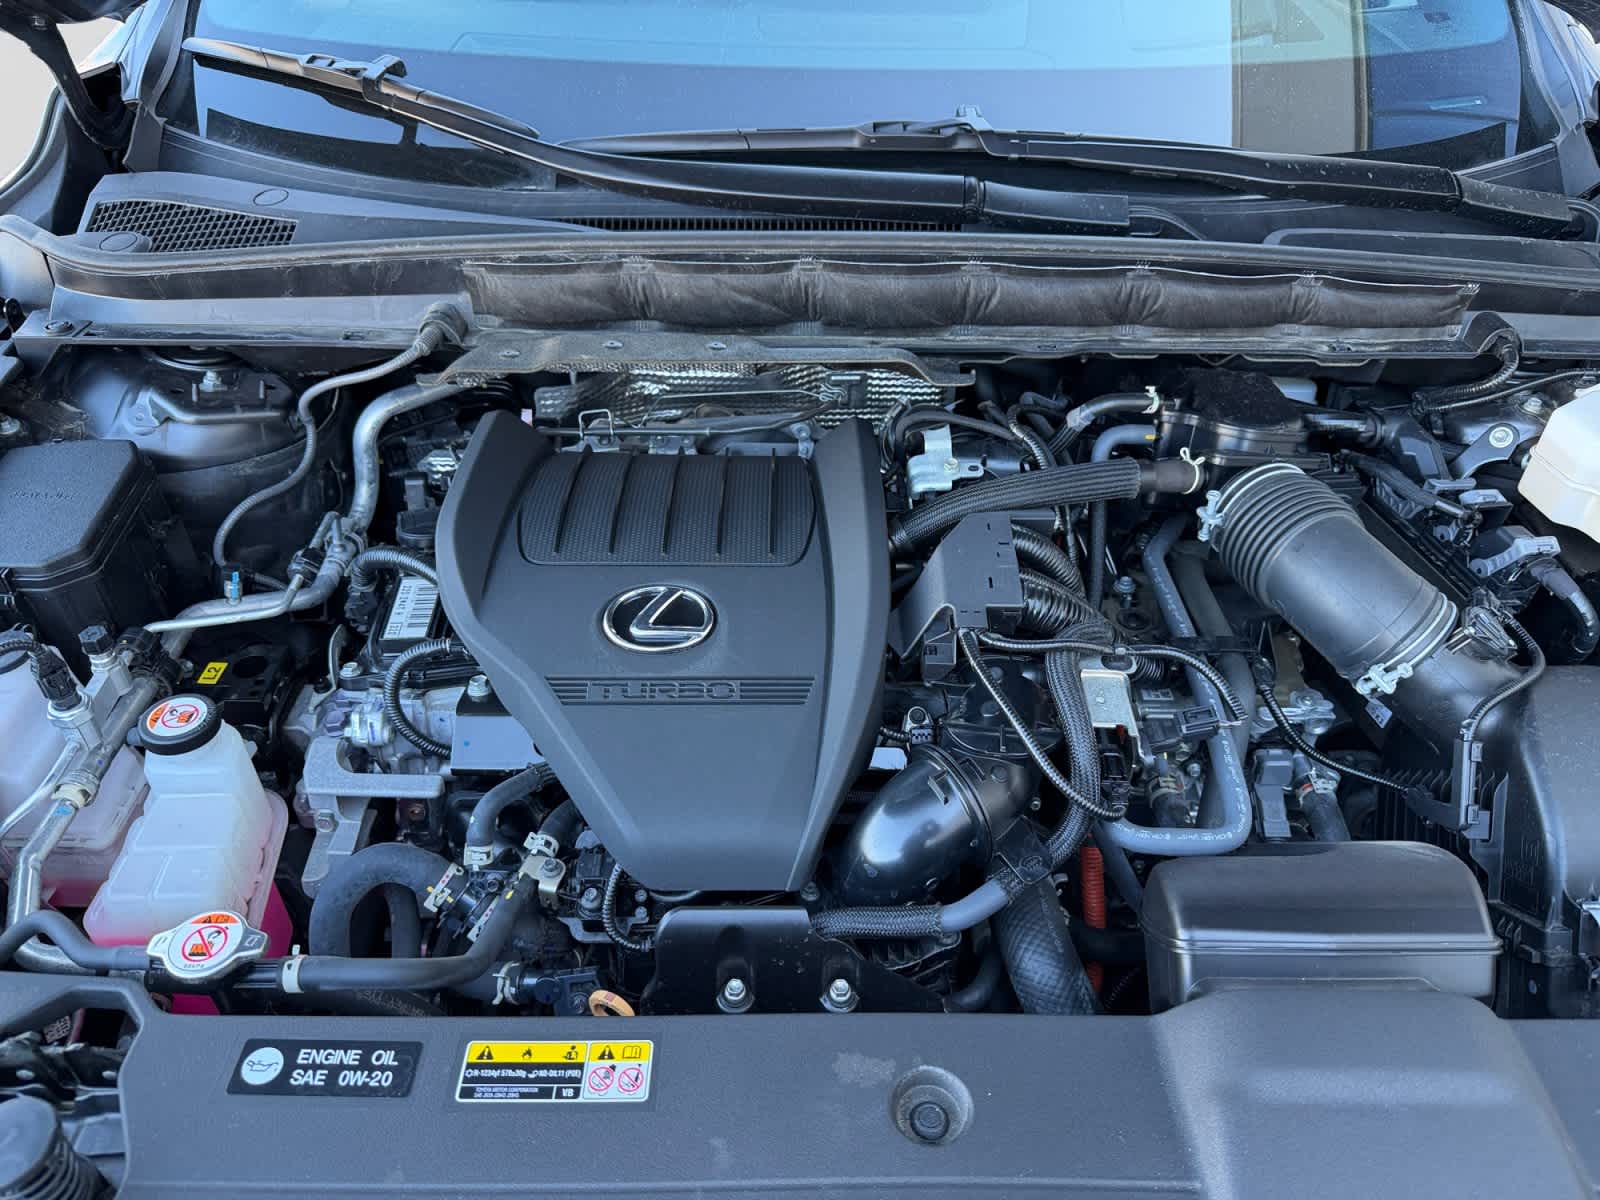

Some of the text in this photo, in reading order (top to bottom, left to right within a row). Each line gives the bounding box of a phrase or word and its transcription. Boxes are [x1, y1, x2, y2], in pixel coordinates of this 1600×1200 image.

[590, 680, 738, 700] TURBO
[296, 1048, 399, 1067] ENGINE OIL
[289, 1069, 393, 1087] SAE 0W-20
